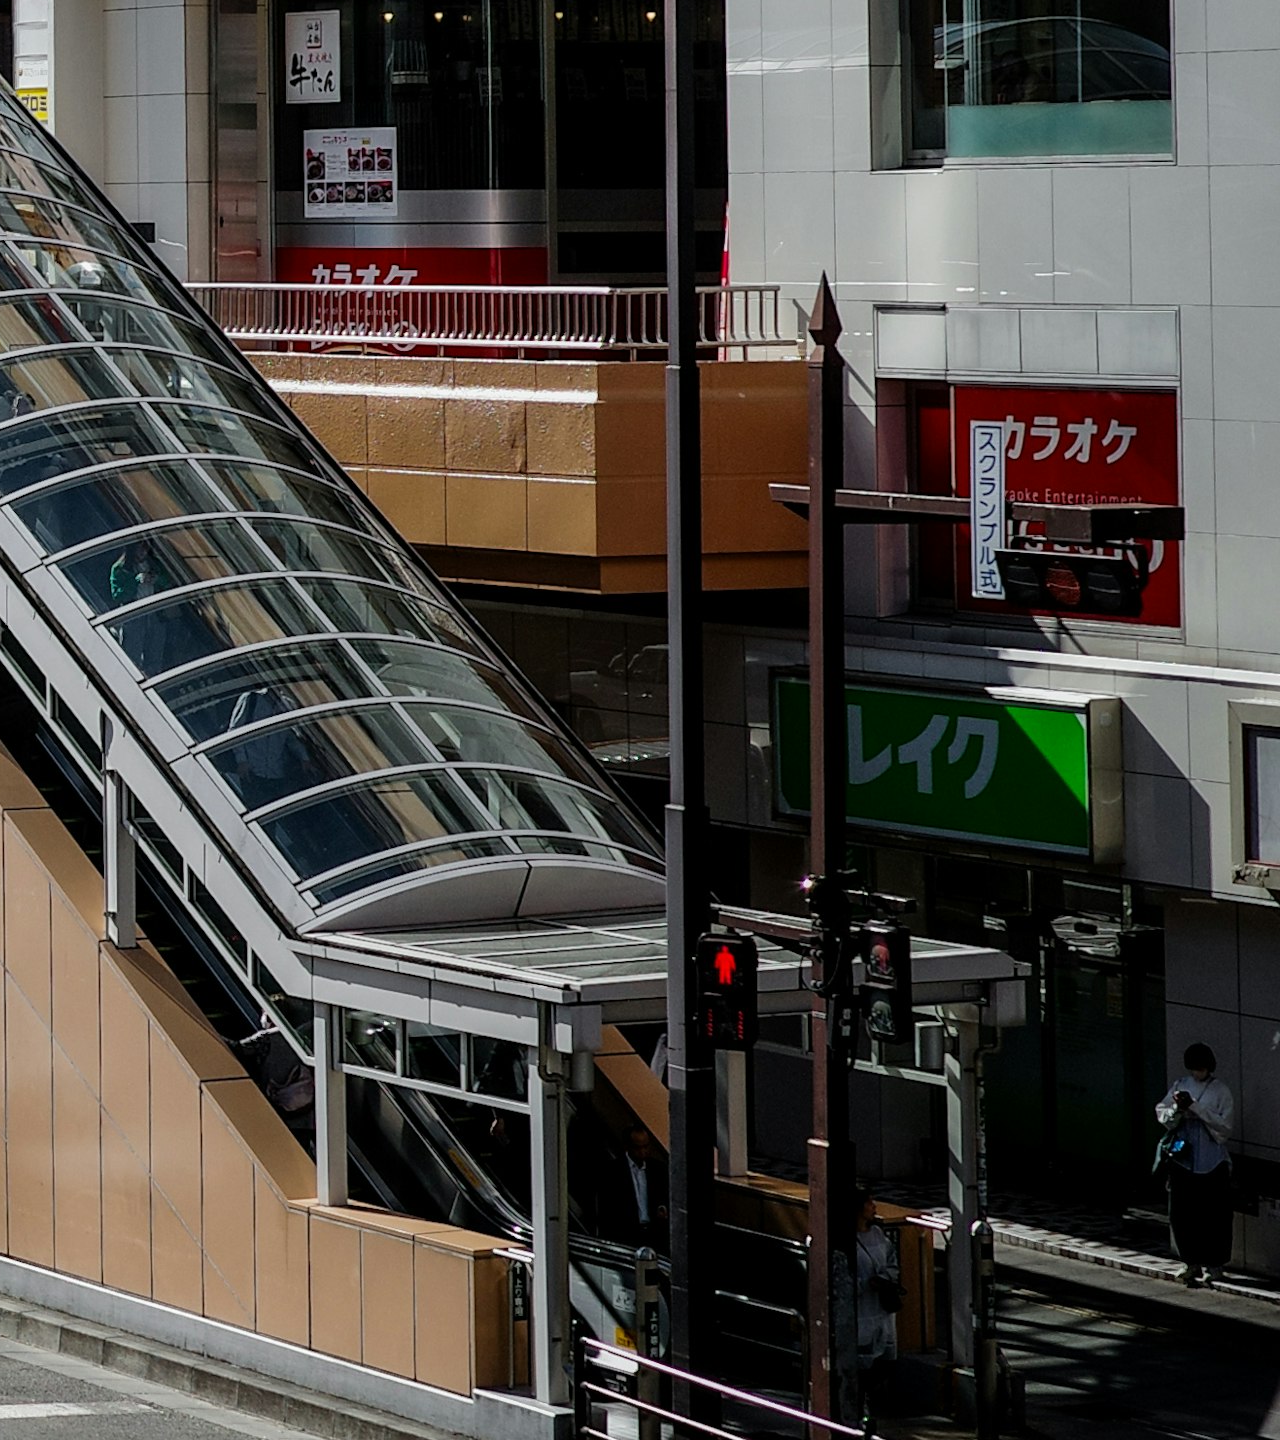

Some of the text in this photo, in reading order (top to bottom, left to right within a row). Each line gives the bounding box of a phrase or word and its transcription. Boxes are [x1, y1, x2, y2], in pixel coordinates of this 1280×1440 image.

[289, 52, 337, 95] 牛たん
[978, 430, 1000, 591] スクランブル式
[845, 703, 1000, 799] レイク
